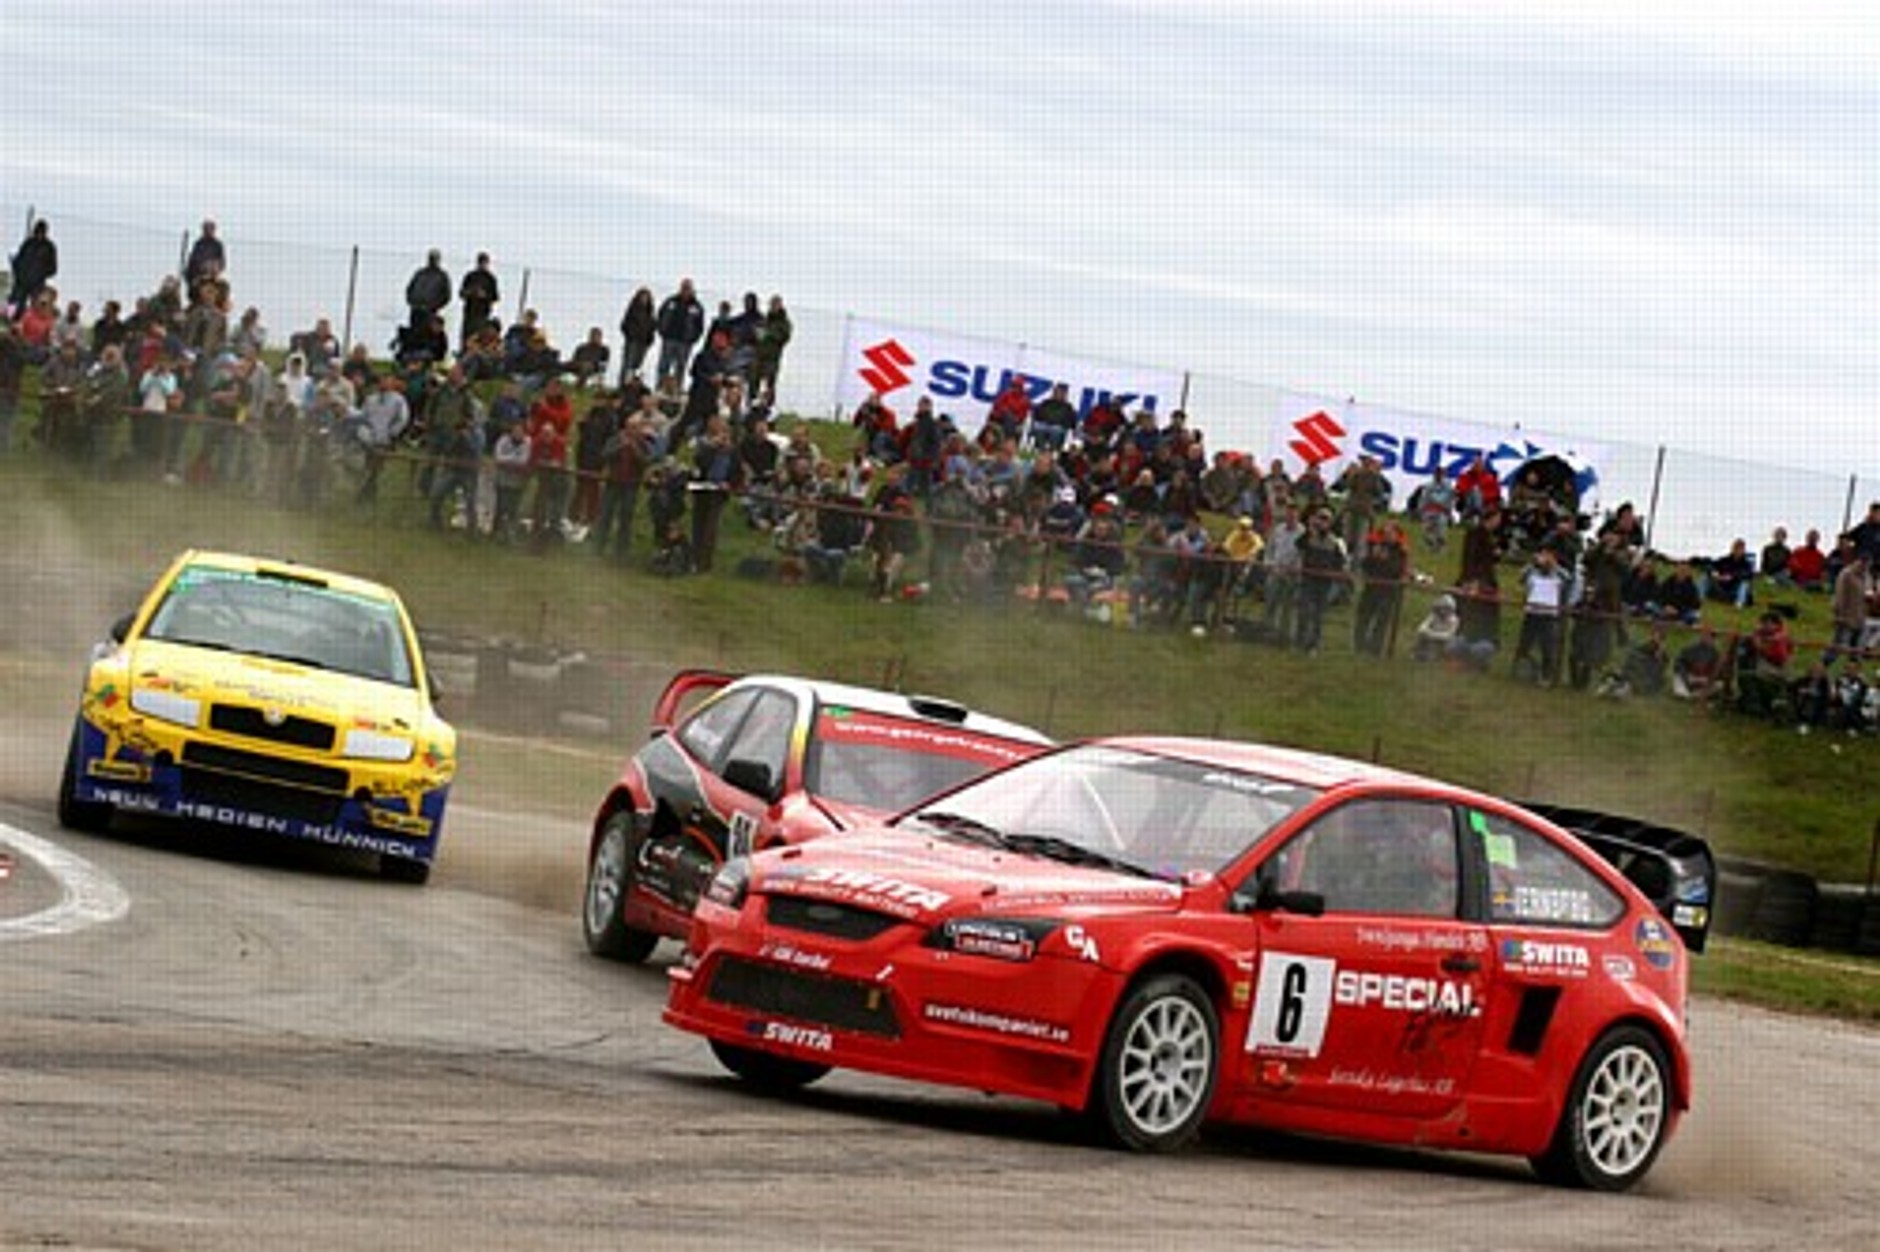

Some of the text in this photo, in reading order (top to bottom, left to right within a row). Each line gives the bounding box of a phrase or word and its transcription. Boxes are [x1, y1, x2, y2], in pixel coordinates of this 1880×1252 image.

[176, 799, 288, 834] MEDIEN
[1521, 941, 1590, 968] SWITA
[1275, 962, 1306, 1043] 6
[763, 1022, 832, 1051] SWITA
